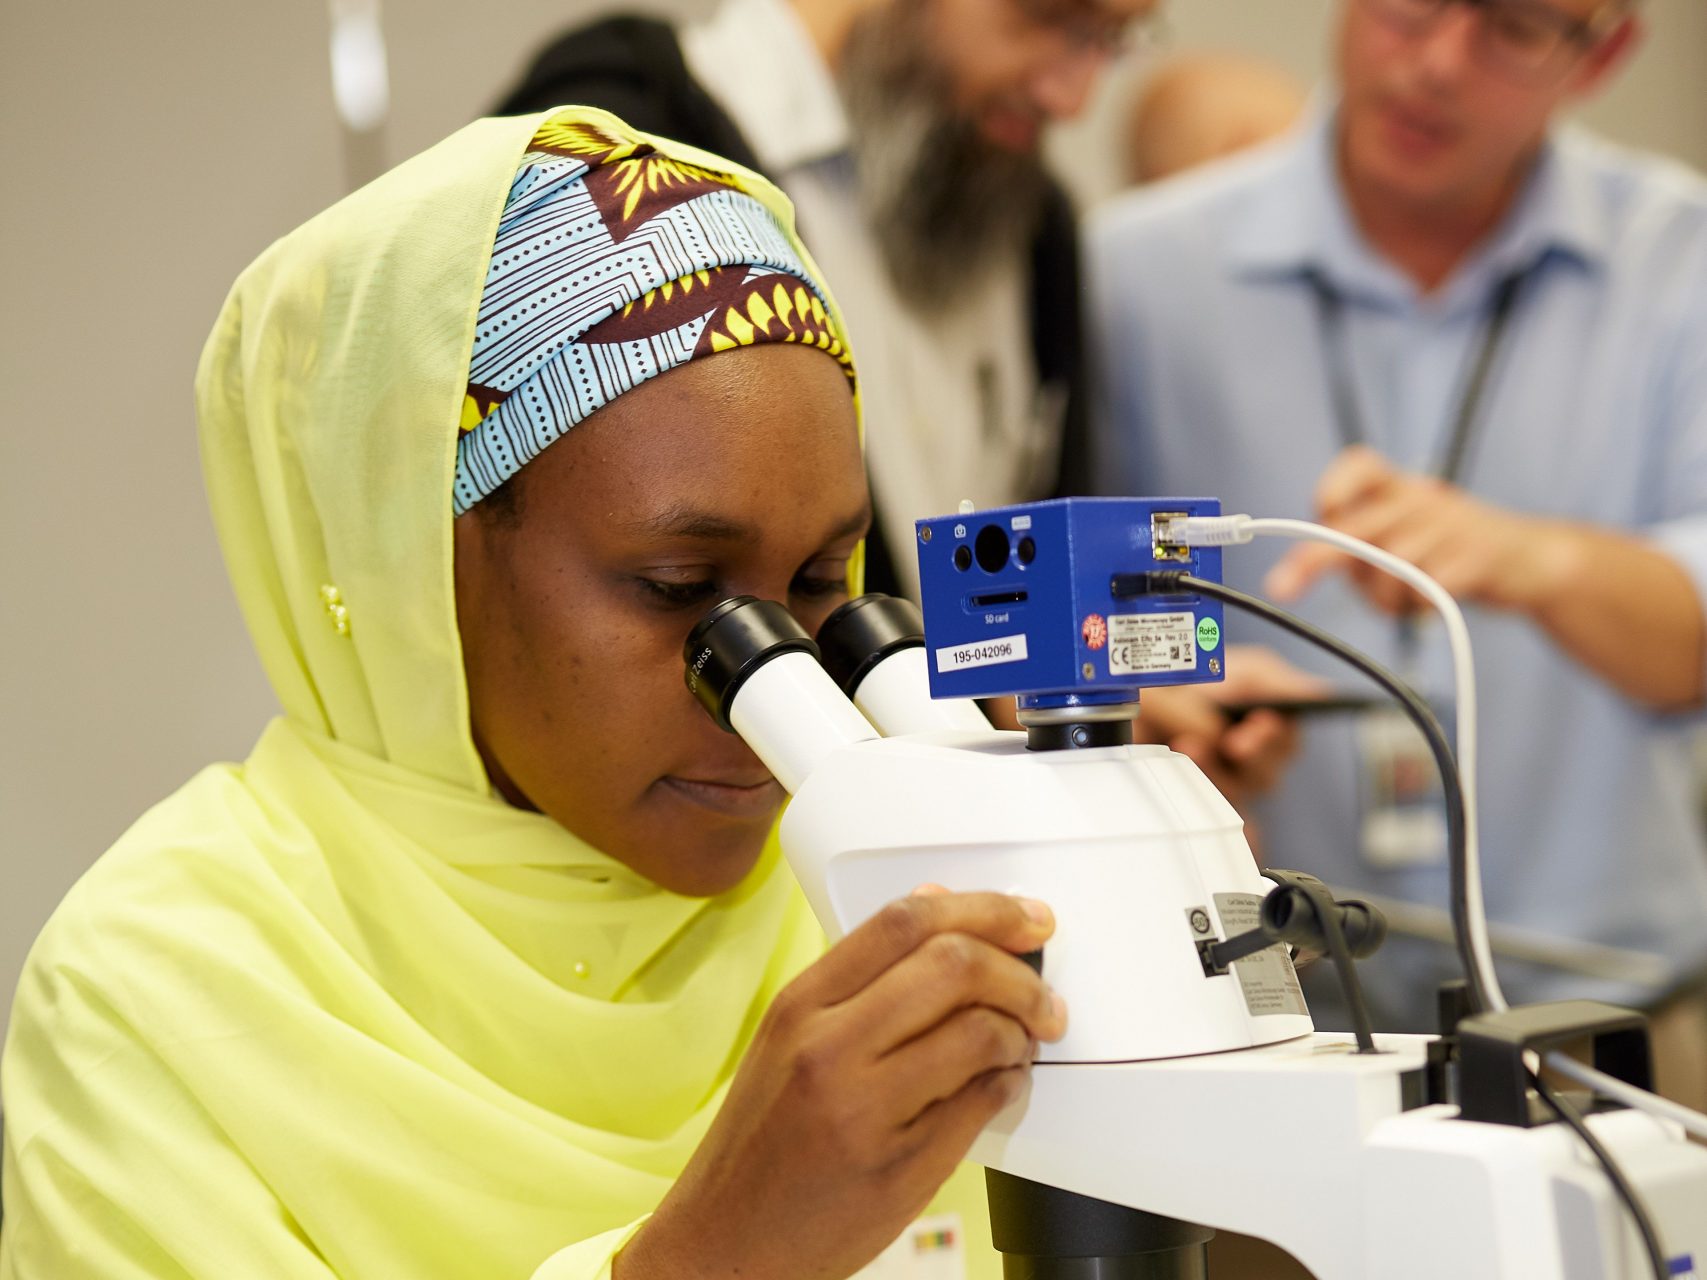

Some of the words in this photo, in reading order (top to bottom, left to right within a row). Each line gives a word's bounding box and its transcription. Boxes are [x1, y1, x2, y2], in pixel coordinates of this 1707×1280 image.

[985, 613, 994, 624] SD
[995, 612, 1009, 623] card
[1199, 626, 1217, 635] RoHS
[691, 647, 713, 675] Zeiss
[953, 643, 1012, 663] 195-042096
